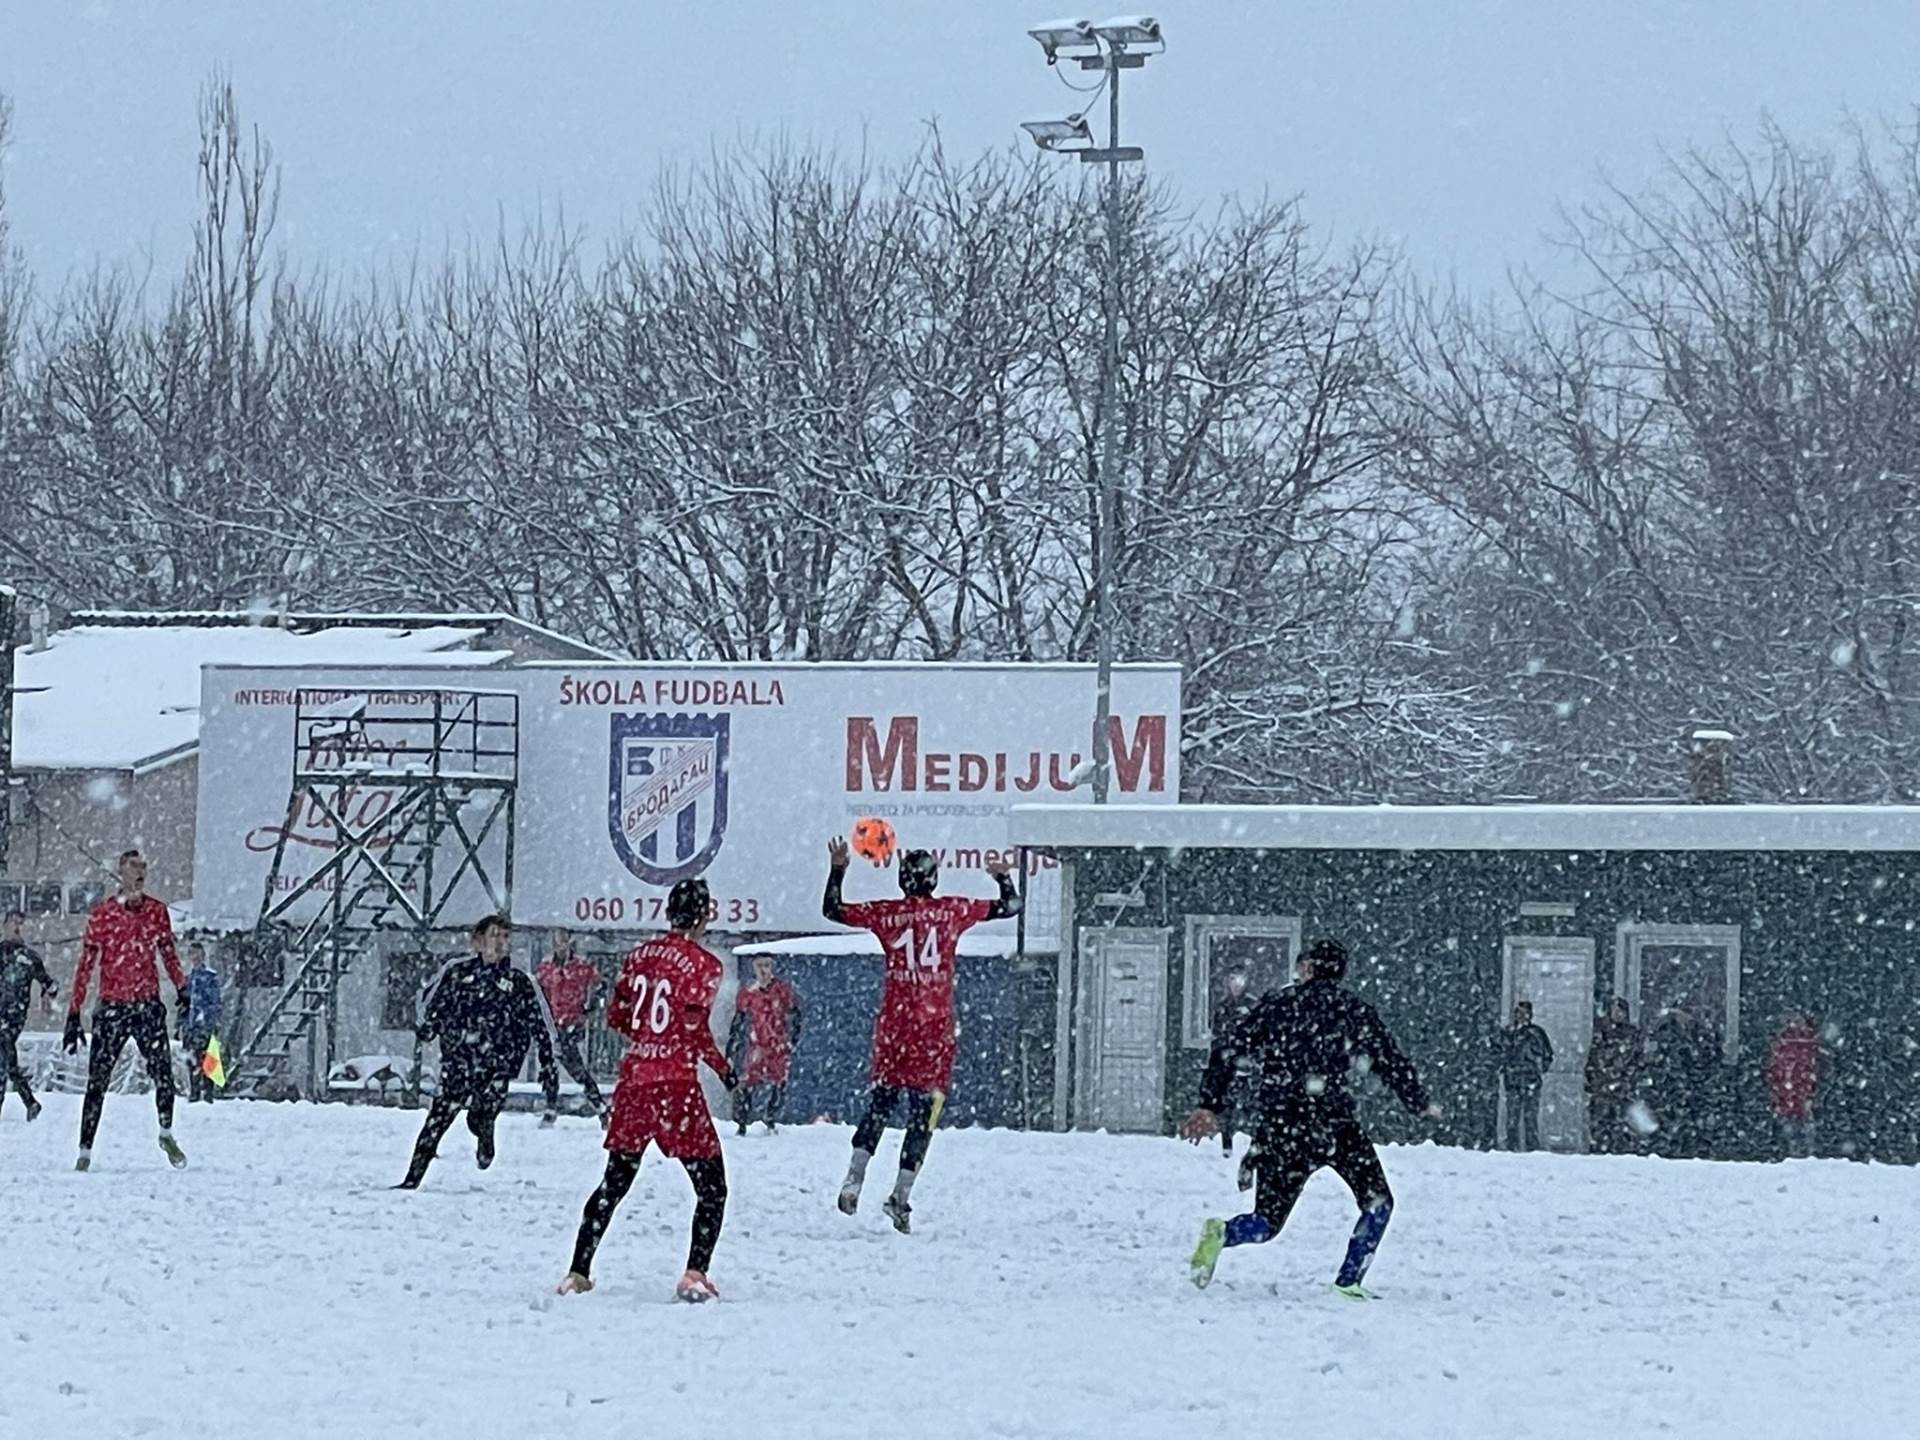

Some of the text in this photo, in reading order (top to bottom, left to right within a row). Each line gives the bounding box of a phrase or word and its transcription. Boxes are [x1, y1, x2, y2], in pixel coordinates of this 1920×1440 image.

[235, 690, 353, 706] INTERNATION
[560, 675, 784, 705] ŠKOLA FUDBALA
[576, 897, 624, 921] 060
[727, 898, 759, 923] 33
[891, 926, 941, 973] 14
[631, 975, 672, 1034] 26
